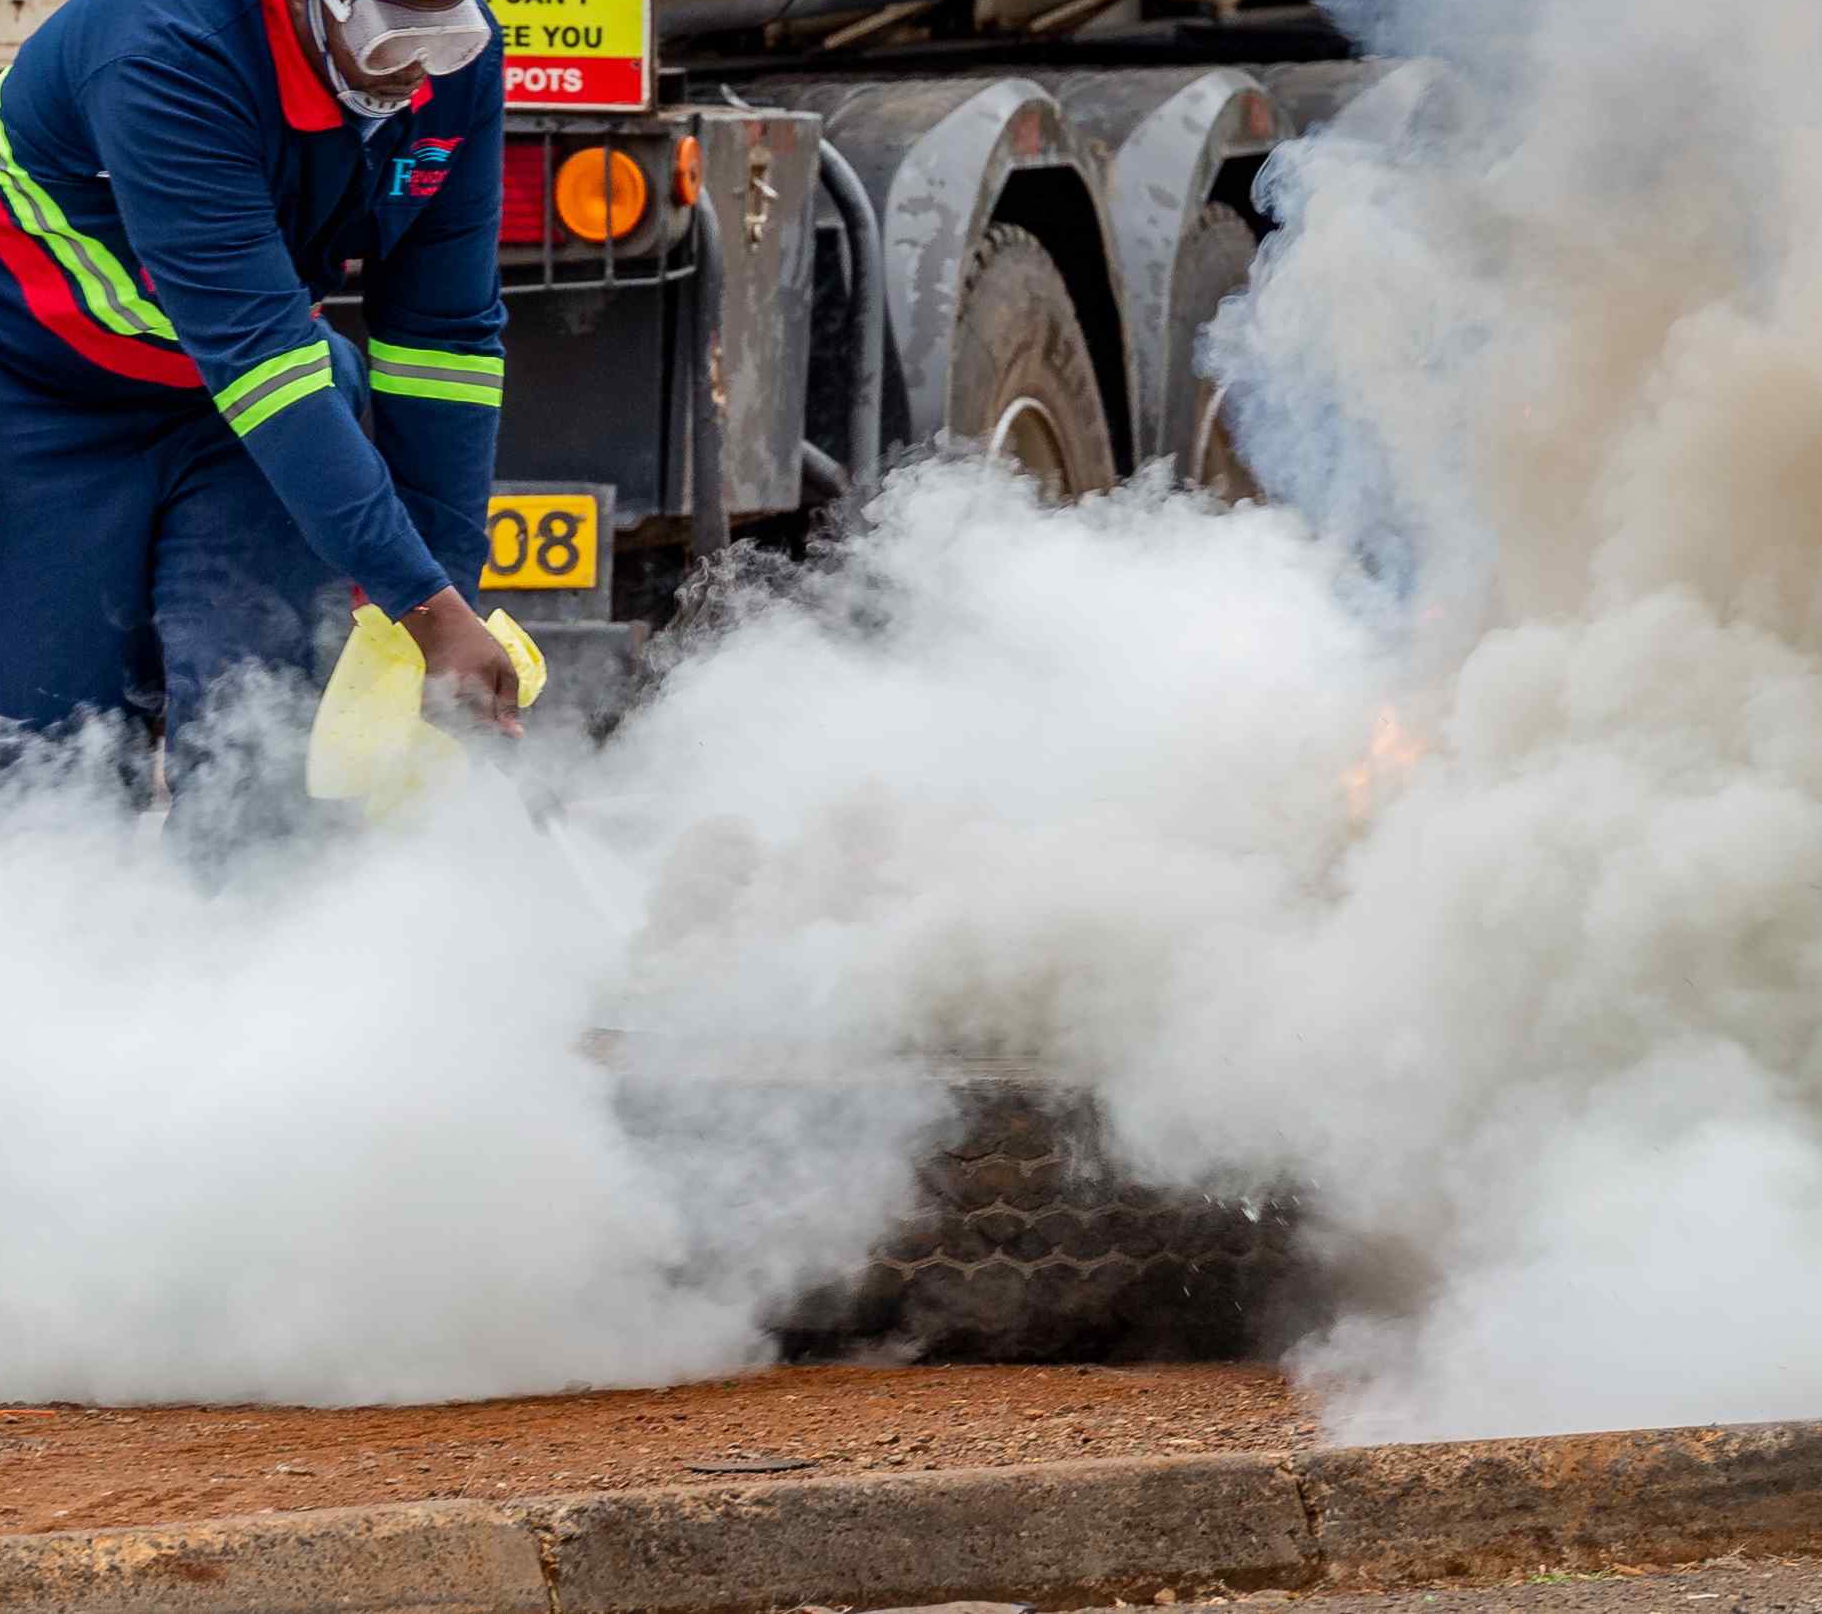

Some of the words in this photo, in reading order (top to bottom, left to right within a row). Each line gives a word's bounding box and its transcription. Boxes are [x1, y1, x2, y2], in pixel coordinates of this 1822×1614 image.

[503, 25, 531, 47] EE
[543, 25, 603, 48] YOU
[505, 67, 583, 92] POTS
